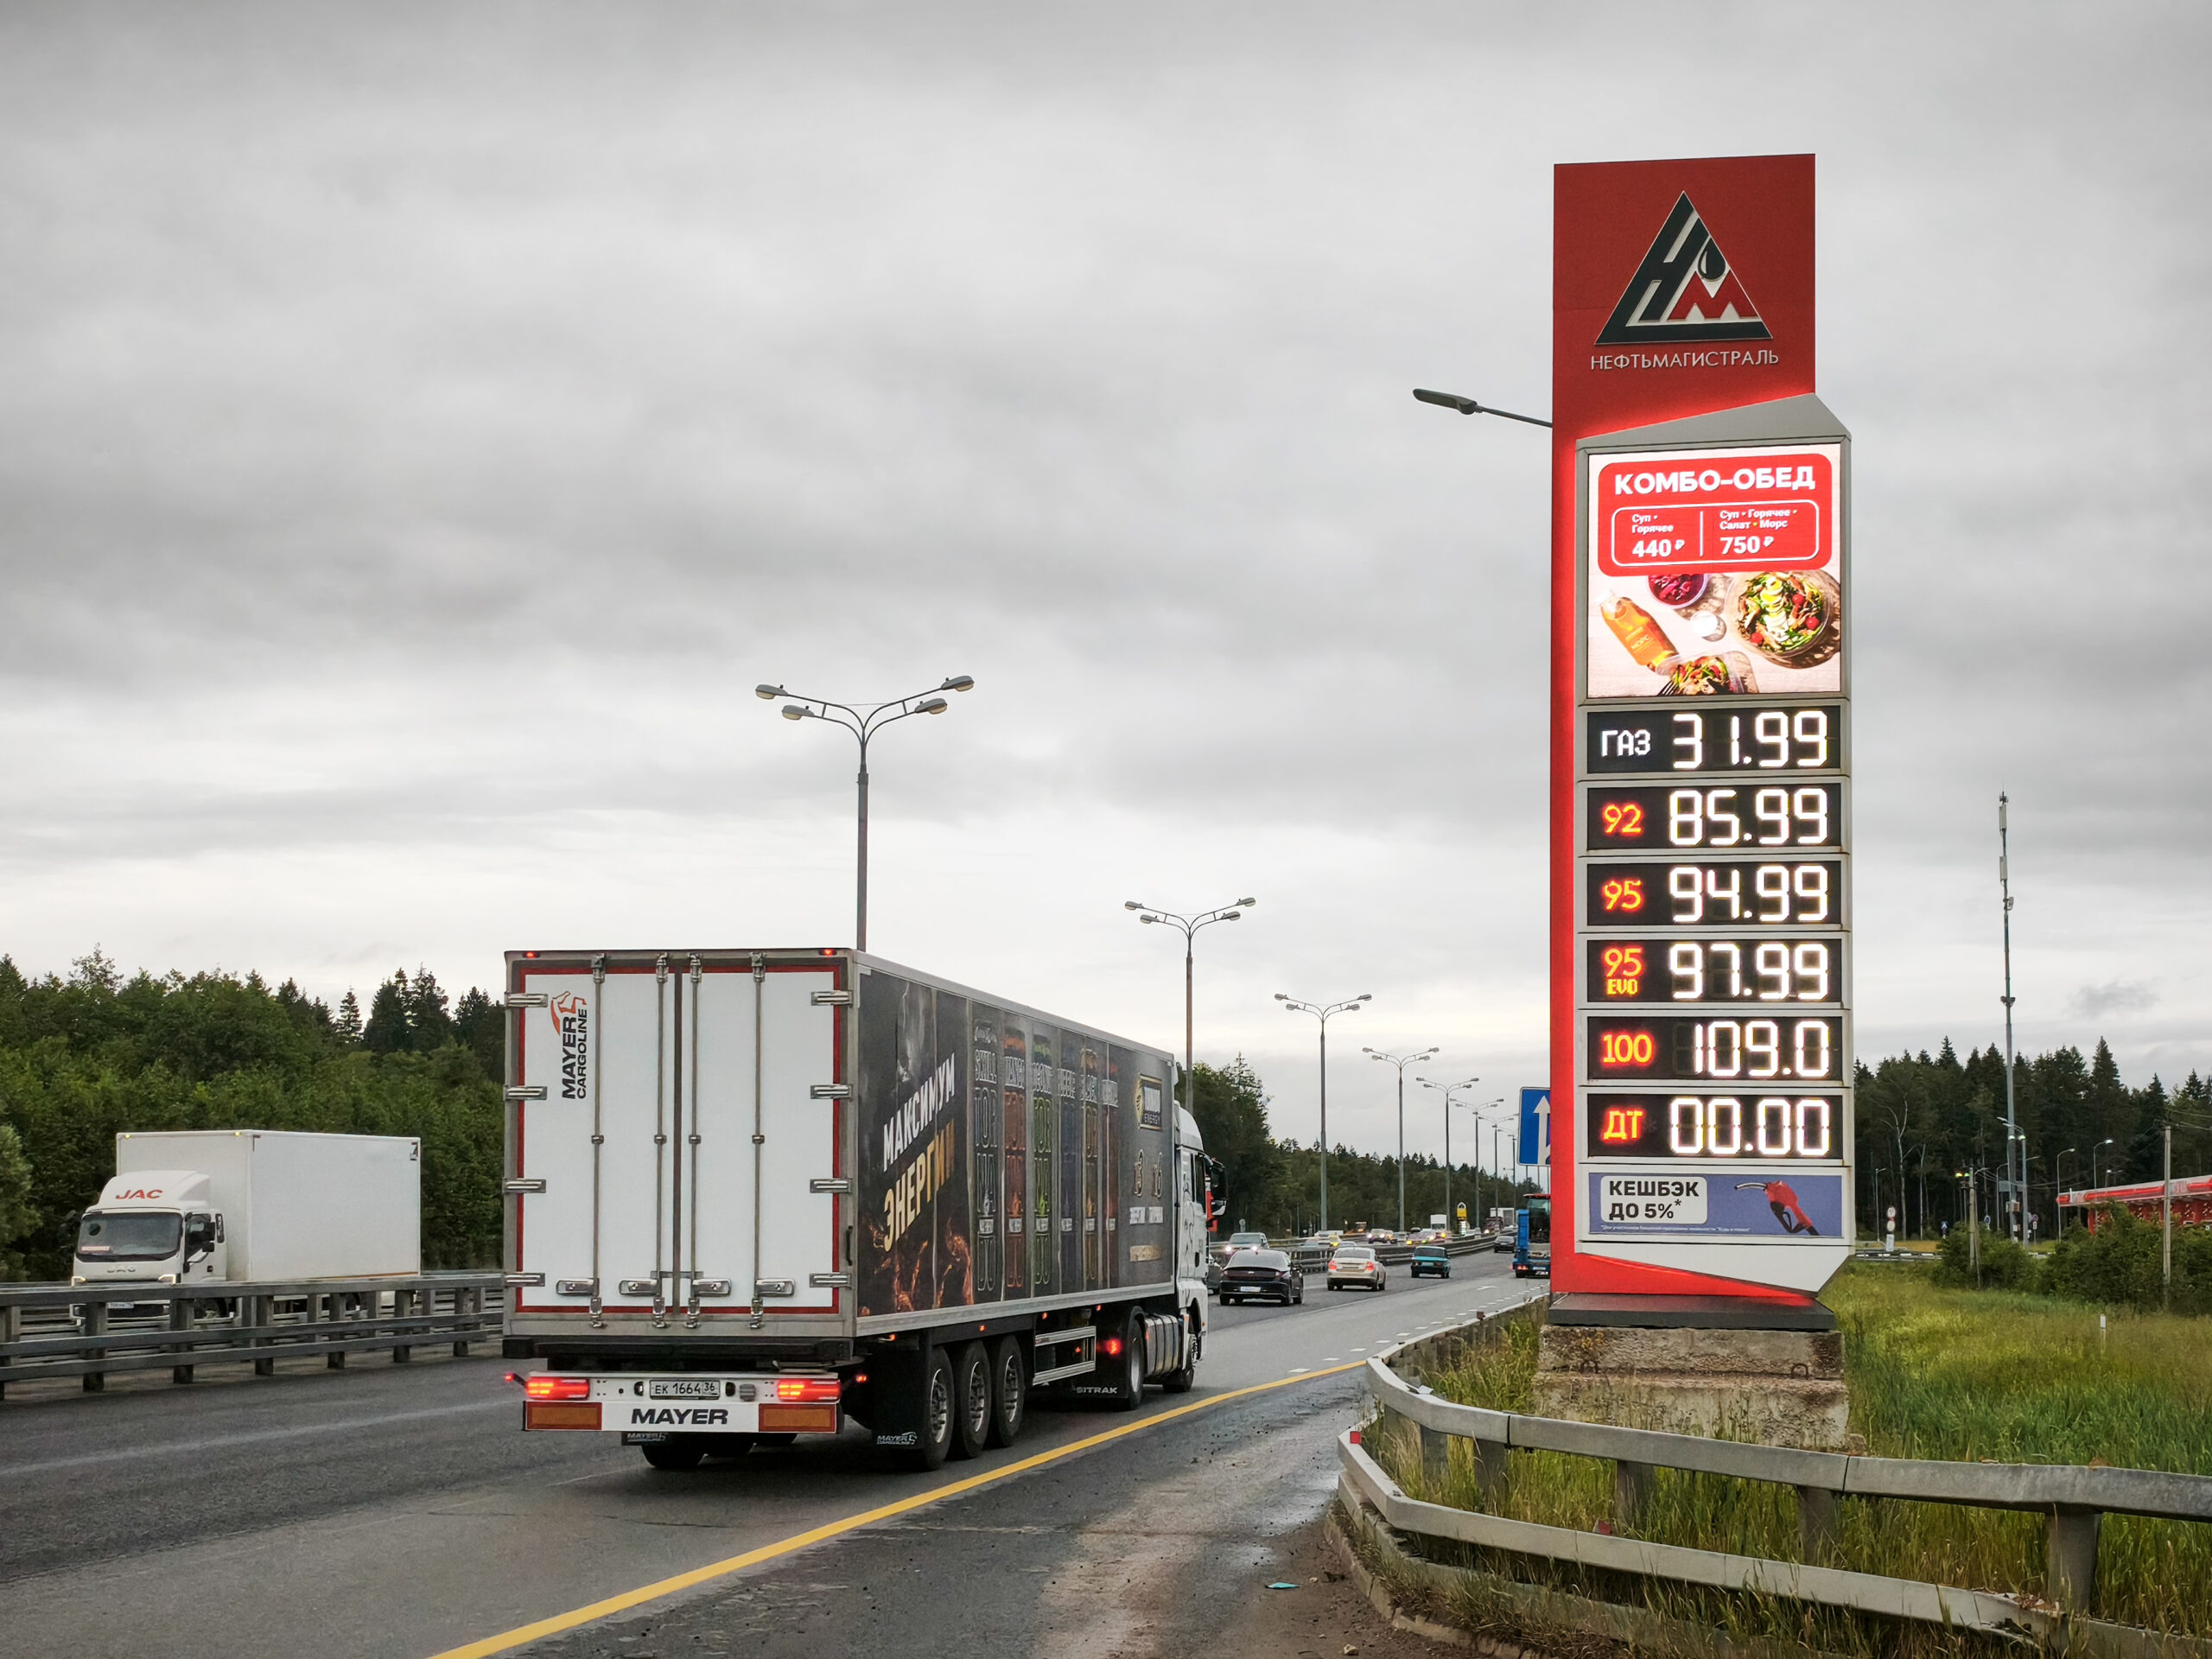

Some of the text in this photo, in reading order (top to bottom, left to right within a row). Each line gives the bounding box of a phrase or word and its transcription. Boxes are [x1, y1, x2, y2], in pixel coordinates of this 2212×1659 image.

[1591, 350, 1779, 370] НЕФТЬМАГИСТРАЛЬ
[1615, 466, 1815, 495] КОМБО-ОБЕД
[1631, 514, 1651, 524] Суп
[1719, 509, 1790, 520] Суп Горячее
[1631, 524, 1674, 534] Горячее
[1719, 520, 1788, 530] Салат Морс
[1631, 539, 1672, 558] 440
[1719, 536, 1760, 555] 750
[1601, 710, 1827, 769] ГАЗ 31.99
[1604, 788, 1827, 845] 92 85.99
[1604, 866, 1827, 923] 95 94.99
[1604, 943, 1827, 1000] 95 97.99
[1607, 979, 1638, 995] EVO
[562, 1016, 576, 1099] MAYER
[577, 1008, 588, 1099] CARGOLINE
[1603, 1020, 1829, 1077] 100 109.0
[883, 1052, 955, 1173] МАКСИМУМ
[1604, 1098, 1829, 1155] ДТ 00.00
[115, 1189, 163, 1199] JAC
[1609, 1180, 1699, 1197] КЕШБЭК
[1609, 1203, 1639, 1220] ДО
[672, 1382, 701, 1395] 1664
[704, 1382, 715, 1391] 36
[632, 1408, 728, 1424] MAYER
